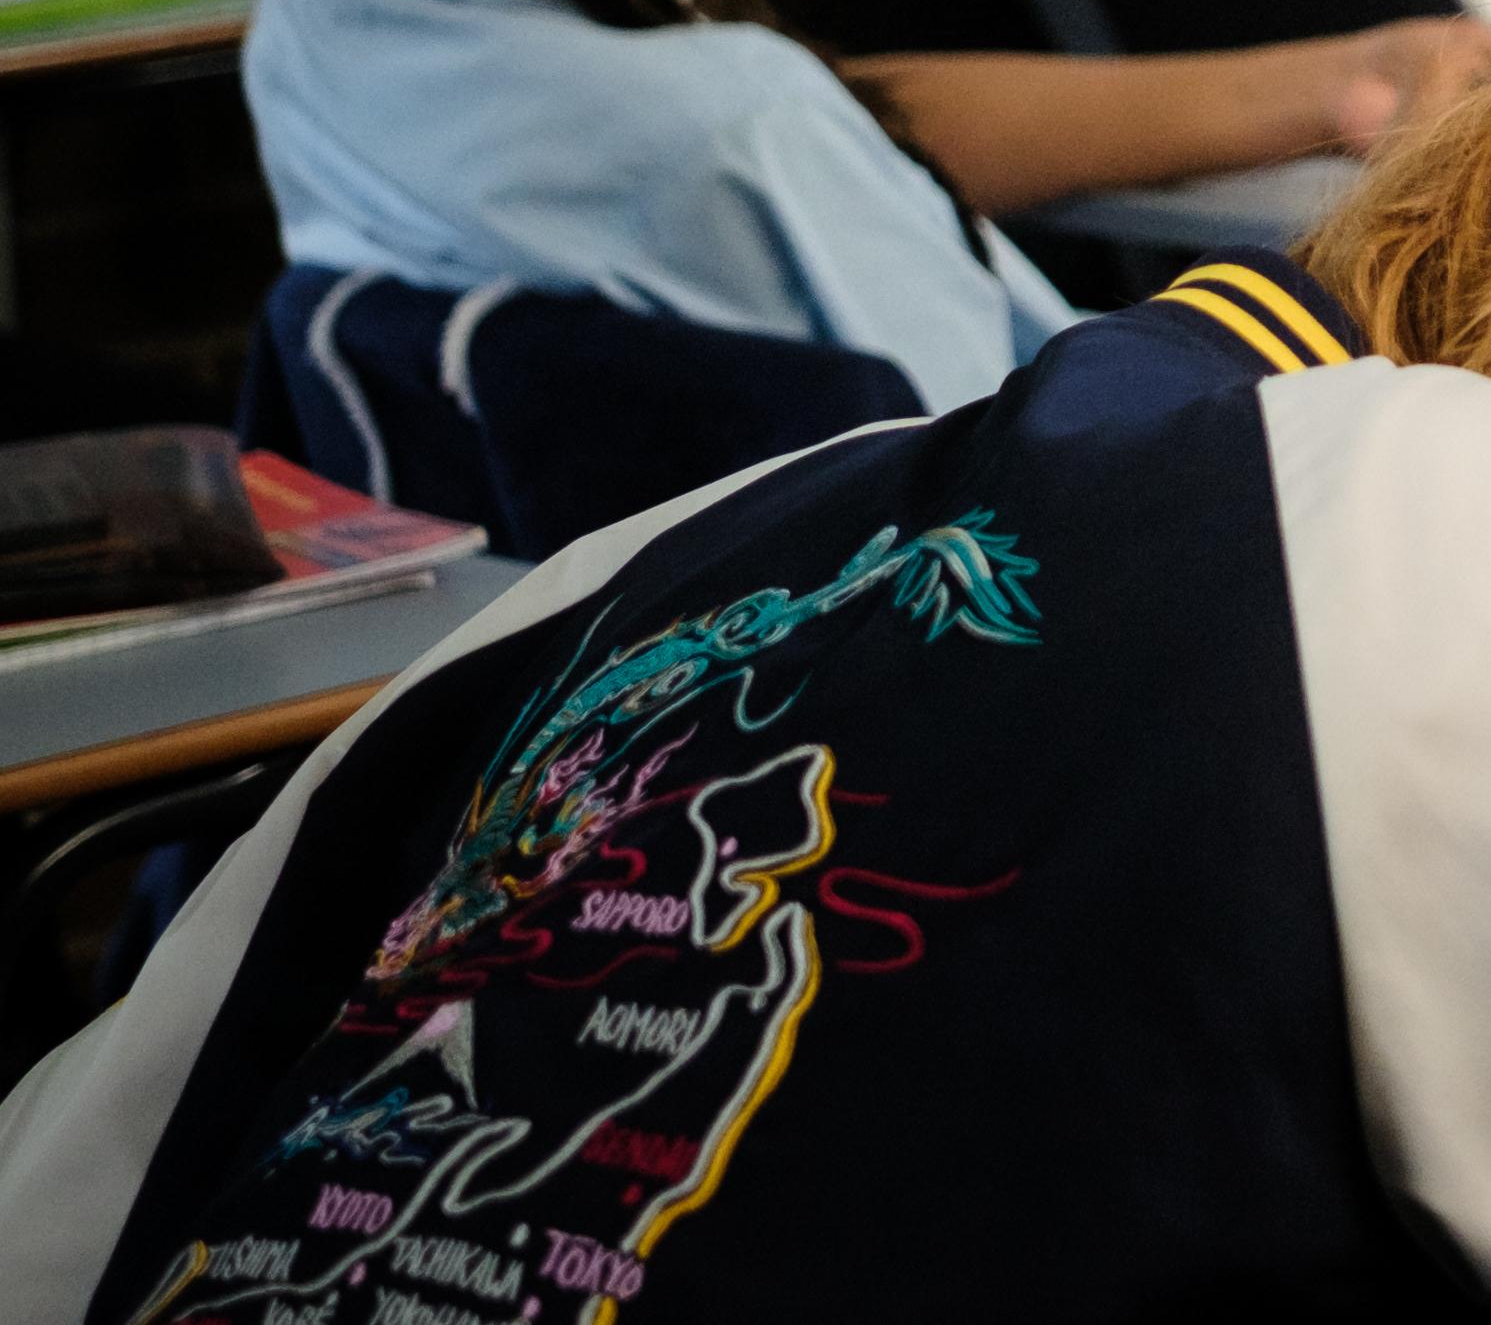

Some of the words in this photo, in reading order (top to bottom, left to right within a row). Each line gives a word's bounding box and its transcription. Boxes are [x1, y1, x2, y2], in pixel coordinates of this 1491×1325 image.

[571, 890, 689, 934] SAPPORO
[309, 1183, 393, 1234] KYOTO
[539, 1227, 646, 1301] TOKYO
